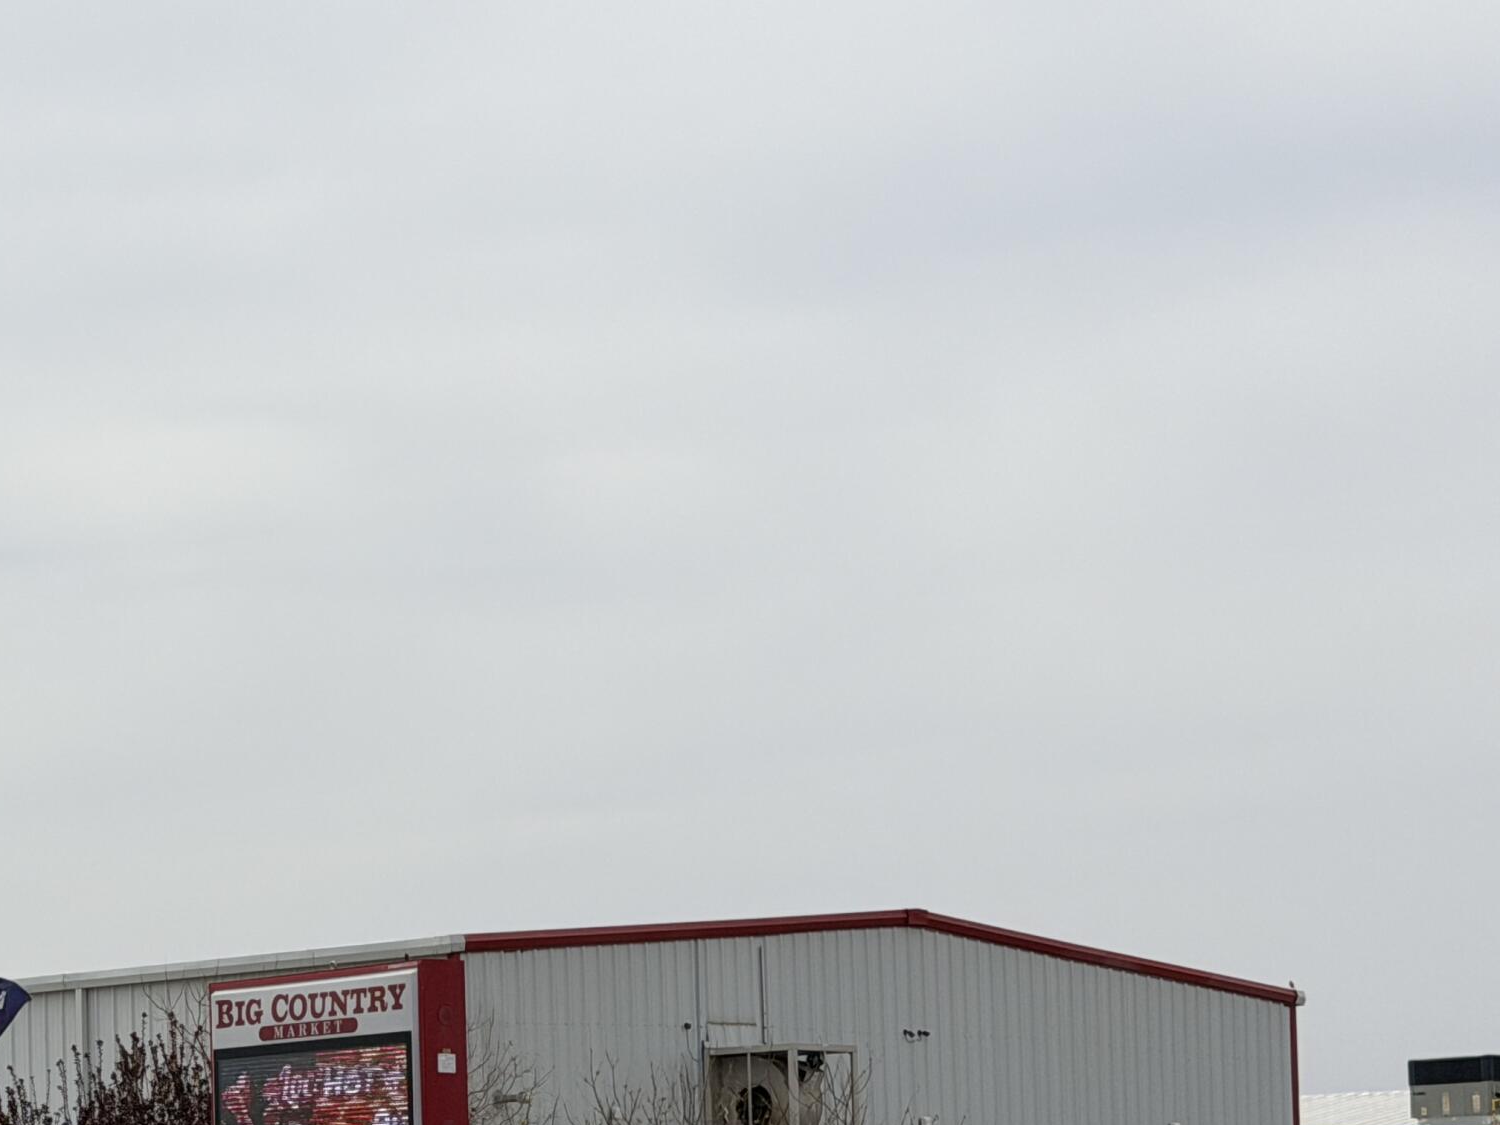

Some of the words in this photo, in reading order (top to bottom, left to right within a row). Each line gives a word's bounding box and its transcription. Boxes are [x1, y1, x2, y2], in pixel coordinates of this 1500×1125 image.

[216, 998, 264, 1029] BIG
[271, 984, 406, 1023] COUNTRY
[273, 1020, 343, 1040] MARKET
